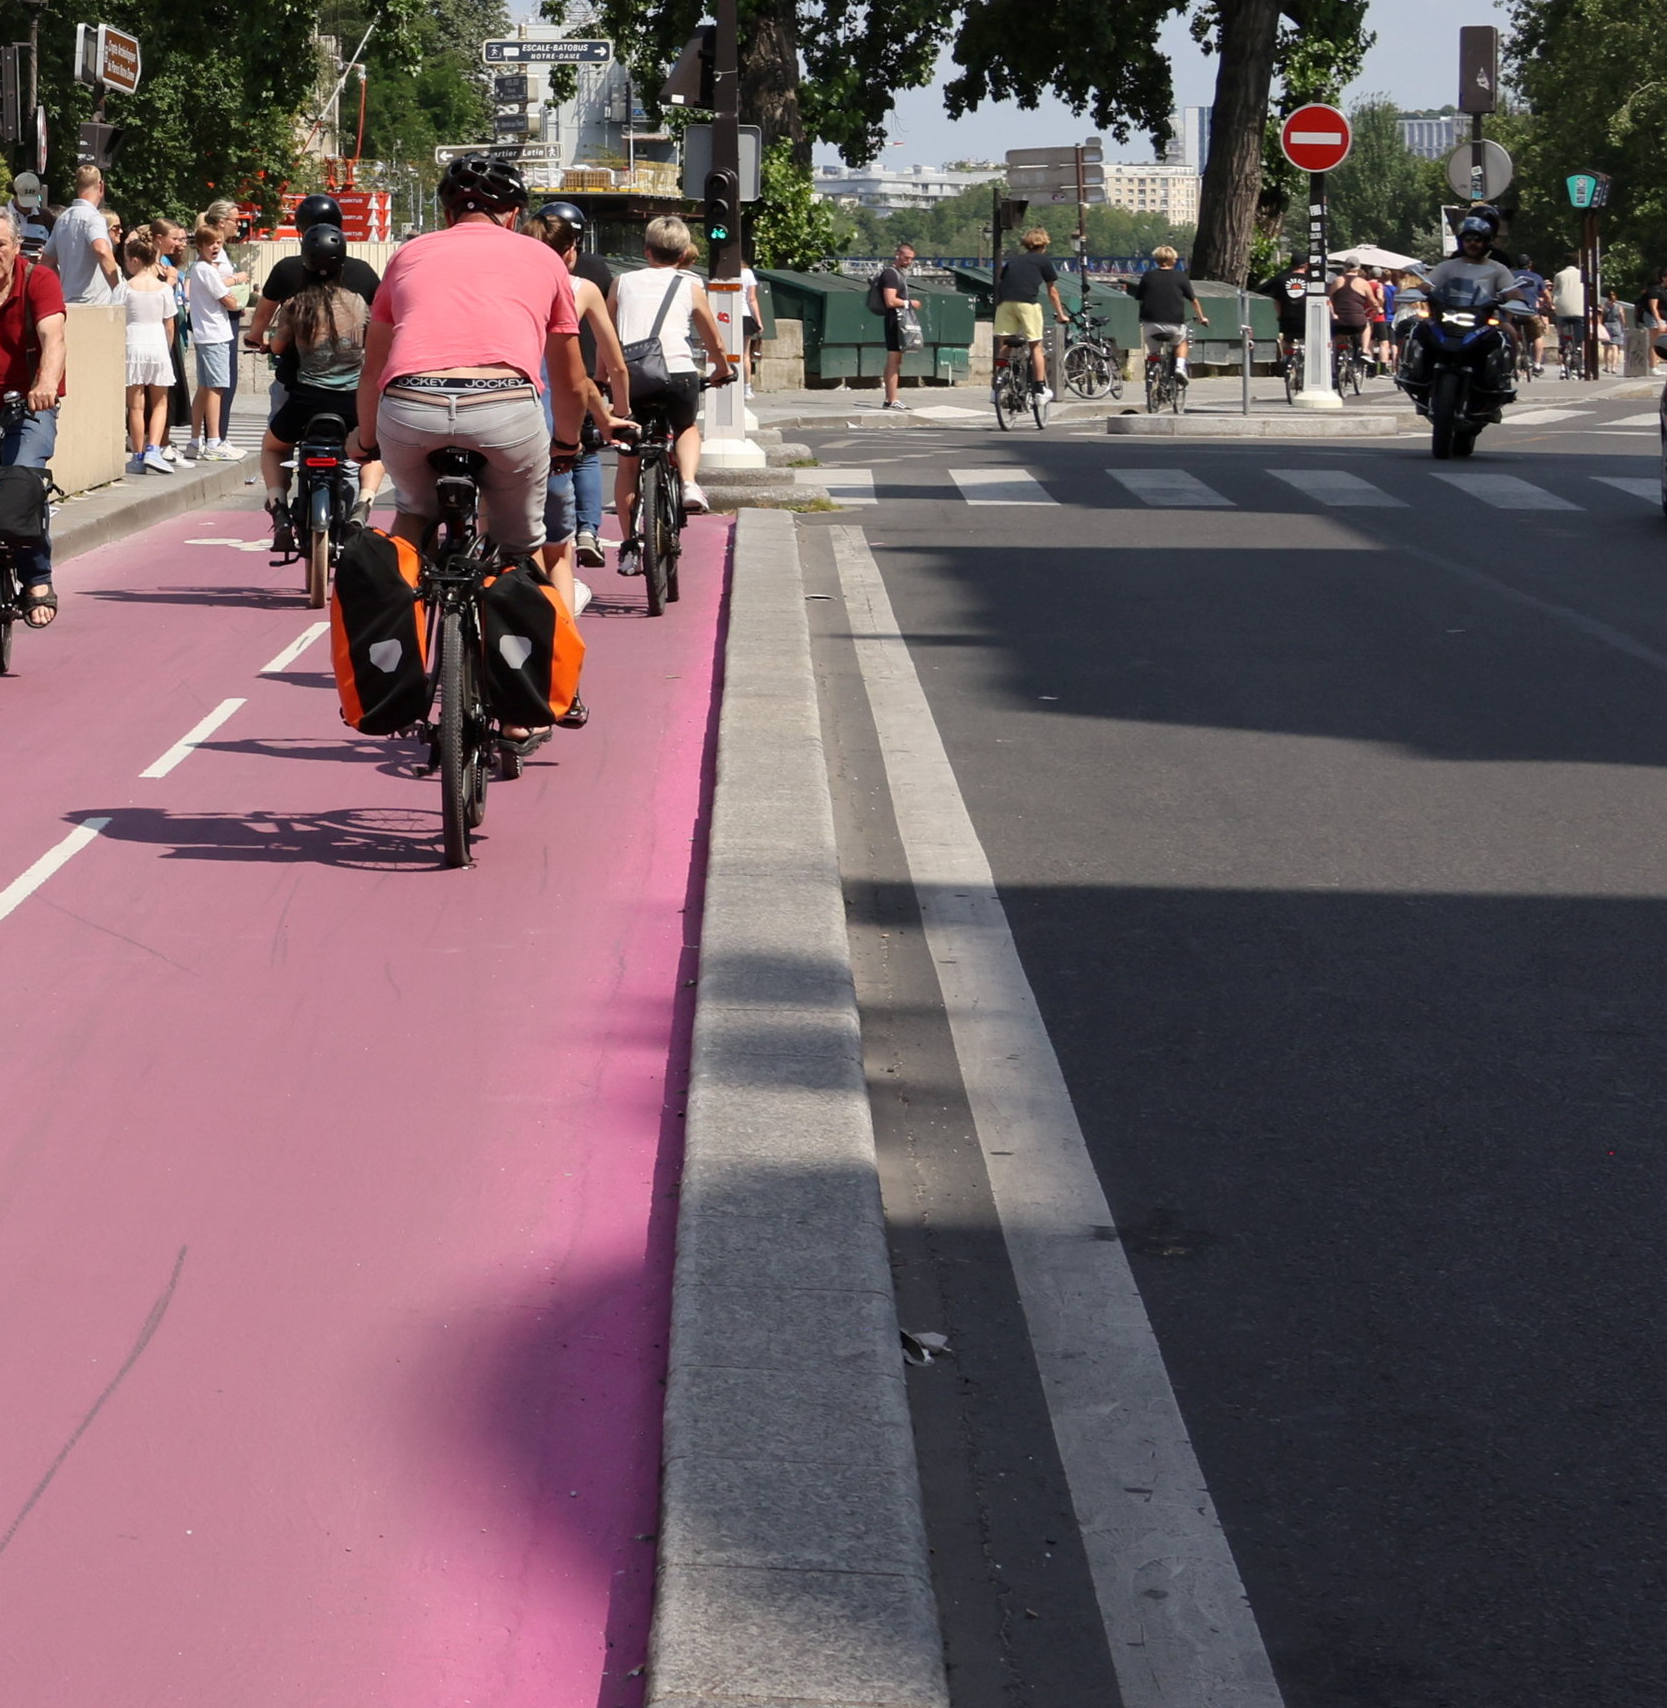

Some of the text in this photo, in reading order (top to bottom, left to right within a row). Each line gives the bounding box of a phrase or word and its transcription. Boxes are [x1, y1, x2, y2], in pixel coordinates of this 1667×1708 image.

[522, 44, 589, 52] ESCALE-BATOBUS
[522, 148, 544, 157] Latin
[465, 378, 524, 389] JOCKEY
